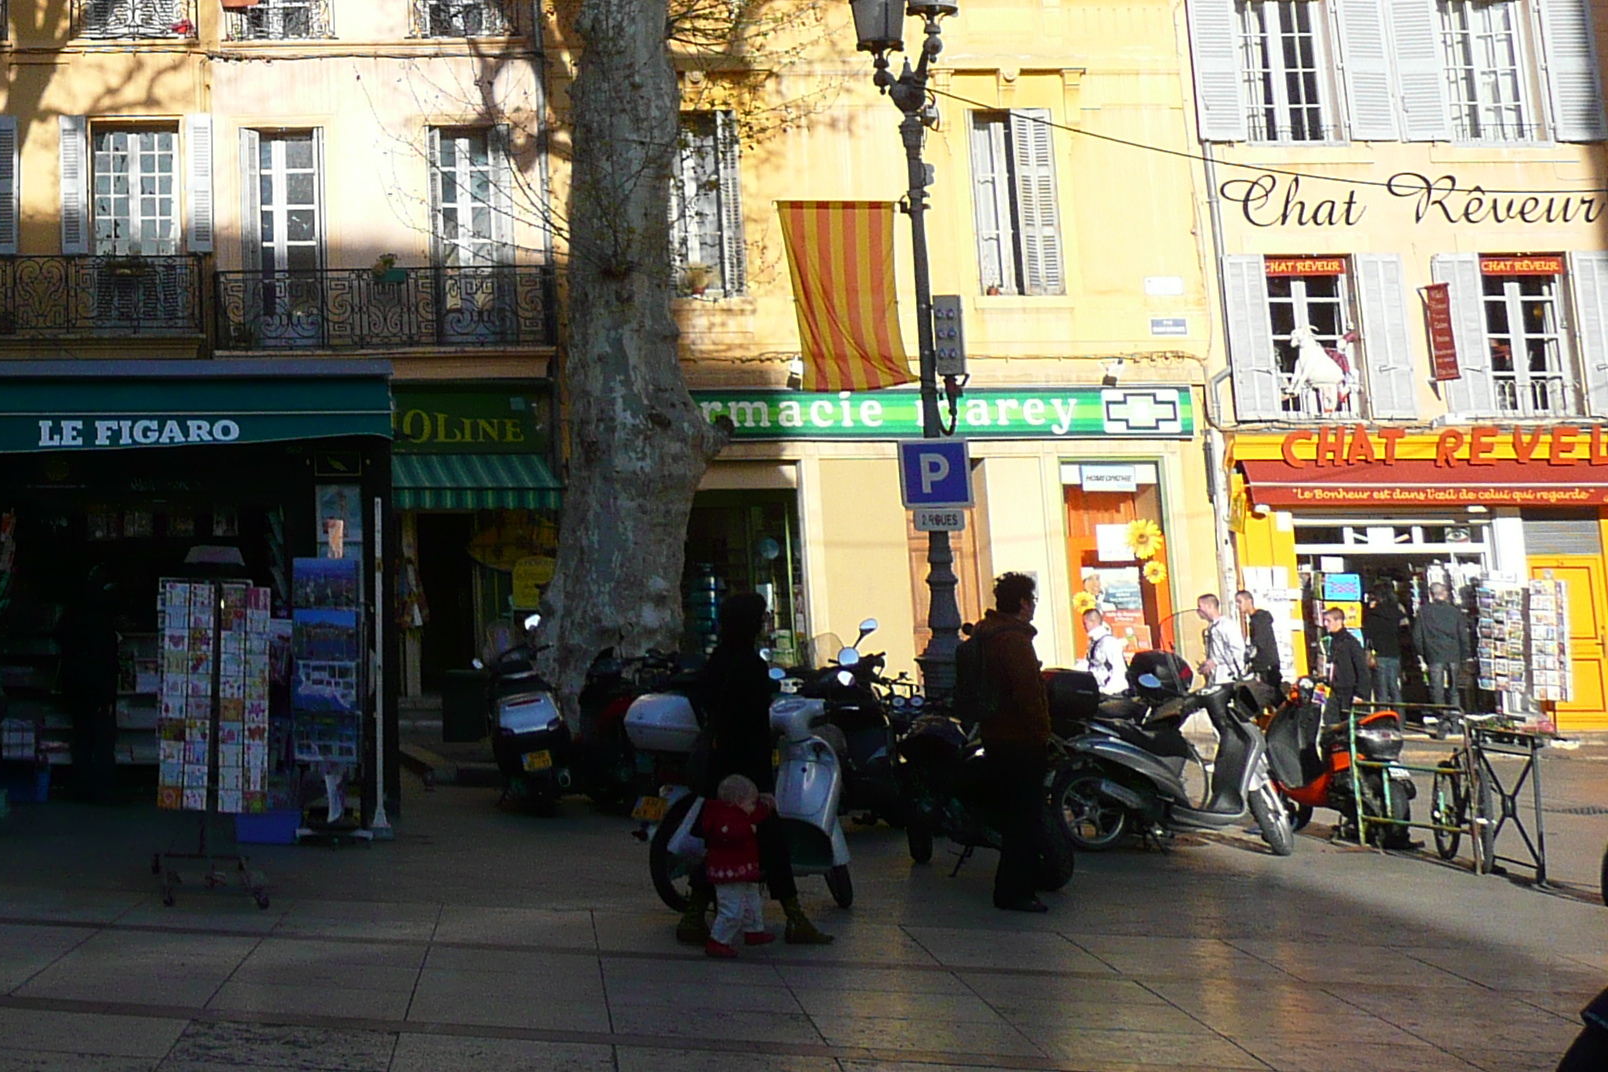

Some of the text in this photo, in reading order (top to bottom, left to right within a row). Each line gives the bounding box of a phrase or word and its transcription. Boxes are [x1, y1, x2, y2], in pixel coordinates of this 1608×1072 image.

[1220, 172, 1606, 228] Chat Rêveur
[1296, 260, 1341, 273] RÊVEUR
[1481, 259, 1559, 272] CHAT RÊVEUR
[38, 418, 241, 447] LE FIGARO
[392, 408, 525, 444] OLINE
[1281, 423, 1406, 469] CHAT
[919, 452, 950, 494] P
[1314, 488, 1371, 500] Bonheur
[1373, 488, 1392, 500] est
[1393, 488, 1426, 501] dans
[1459, 488, 1477, 500] de
[1478, 488, 1511, 500] celui
[1512, 488, 1536, 502] qui
[922, 514, 959, 526] 2 ROUES
